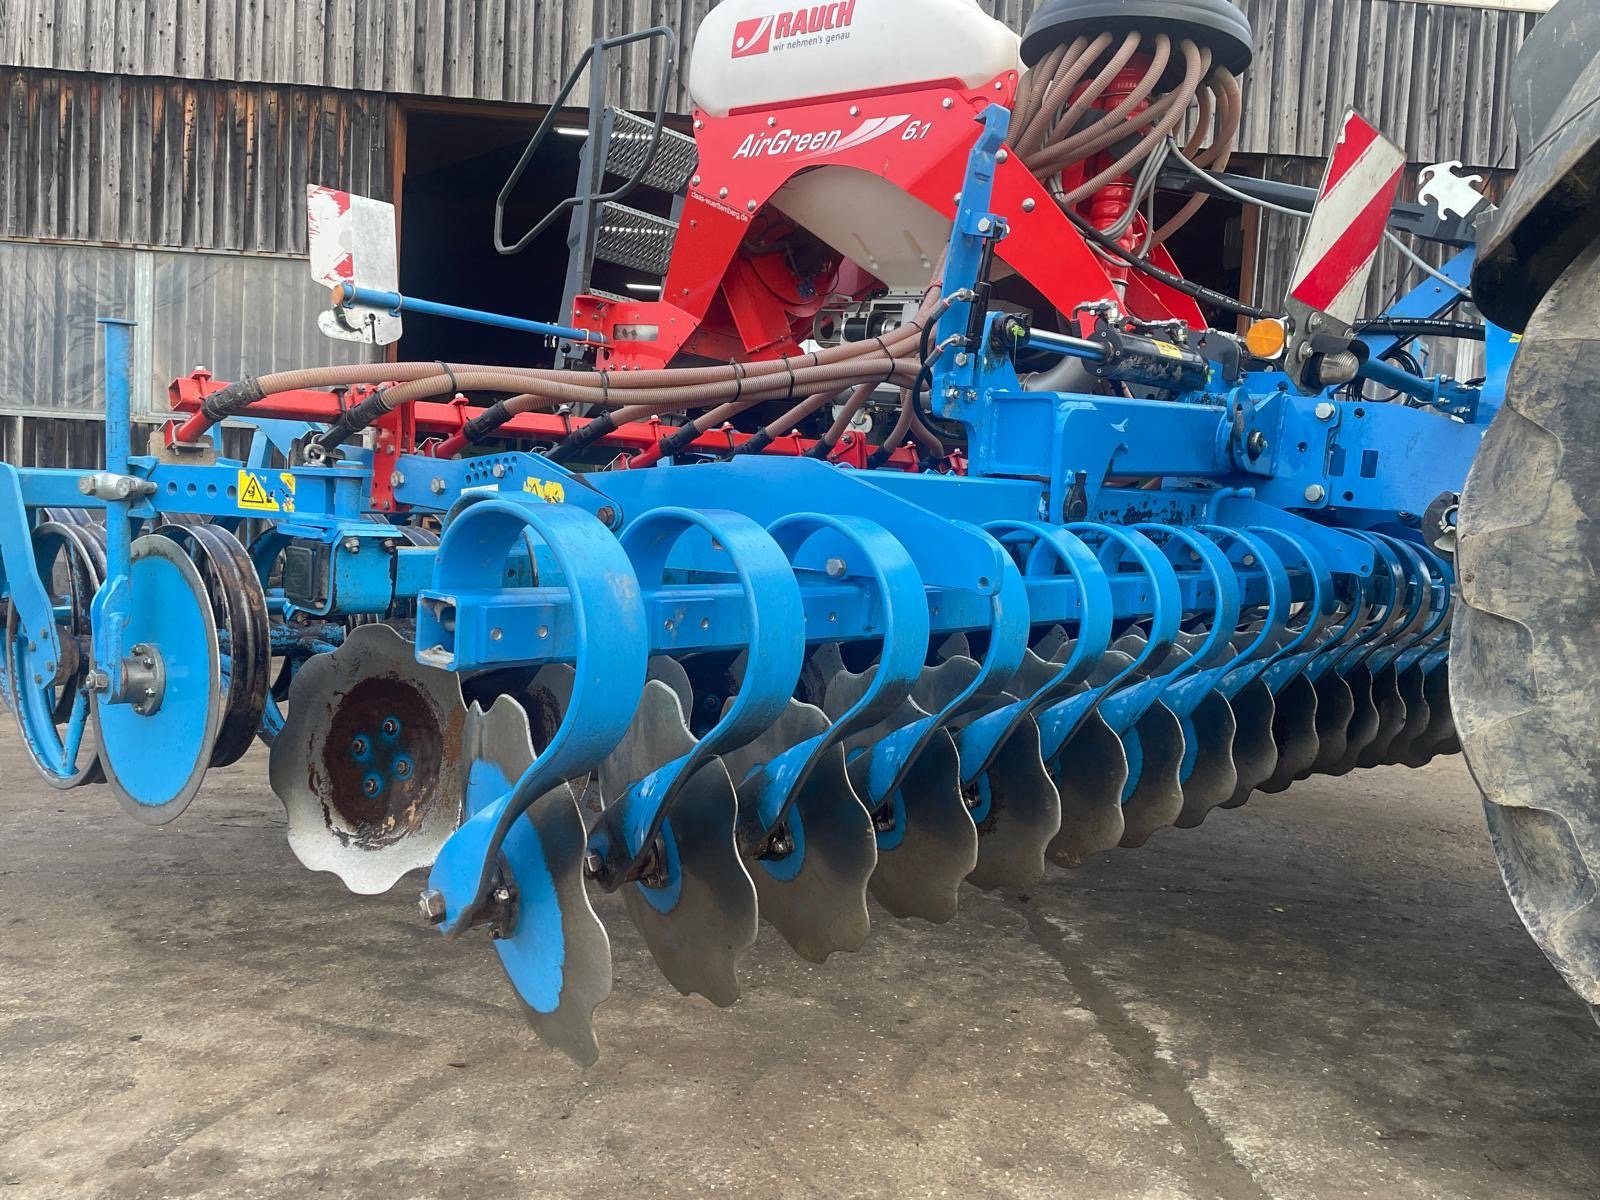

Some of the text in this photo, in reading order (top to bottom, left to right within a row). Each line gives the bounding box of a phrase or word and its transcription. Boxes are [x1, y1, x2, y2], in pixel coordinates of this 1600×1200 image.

[774, 0, 856, 39] RAUCH
[773, 31, 850, 52] wir nehmen's genau
[732, 120, 931, 160] AirGreen 6.1
